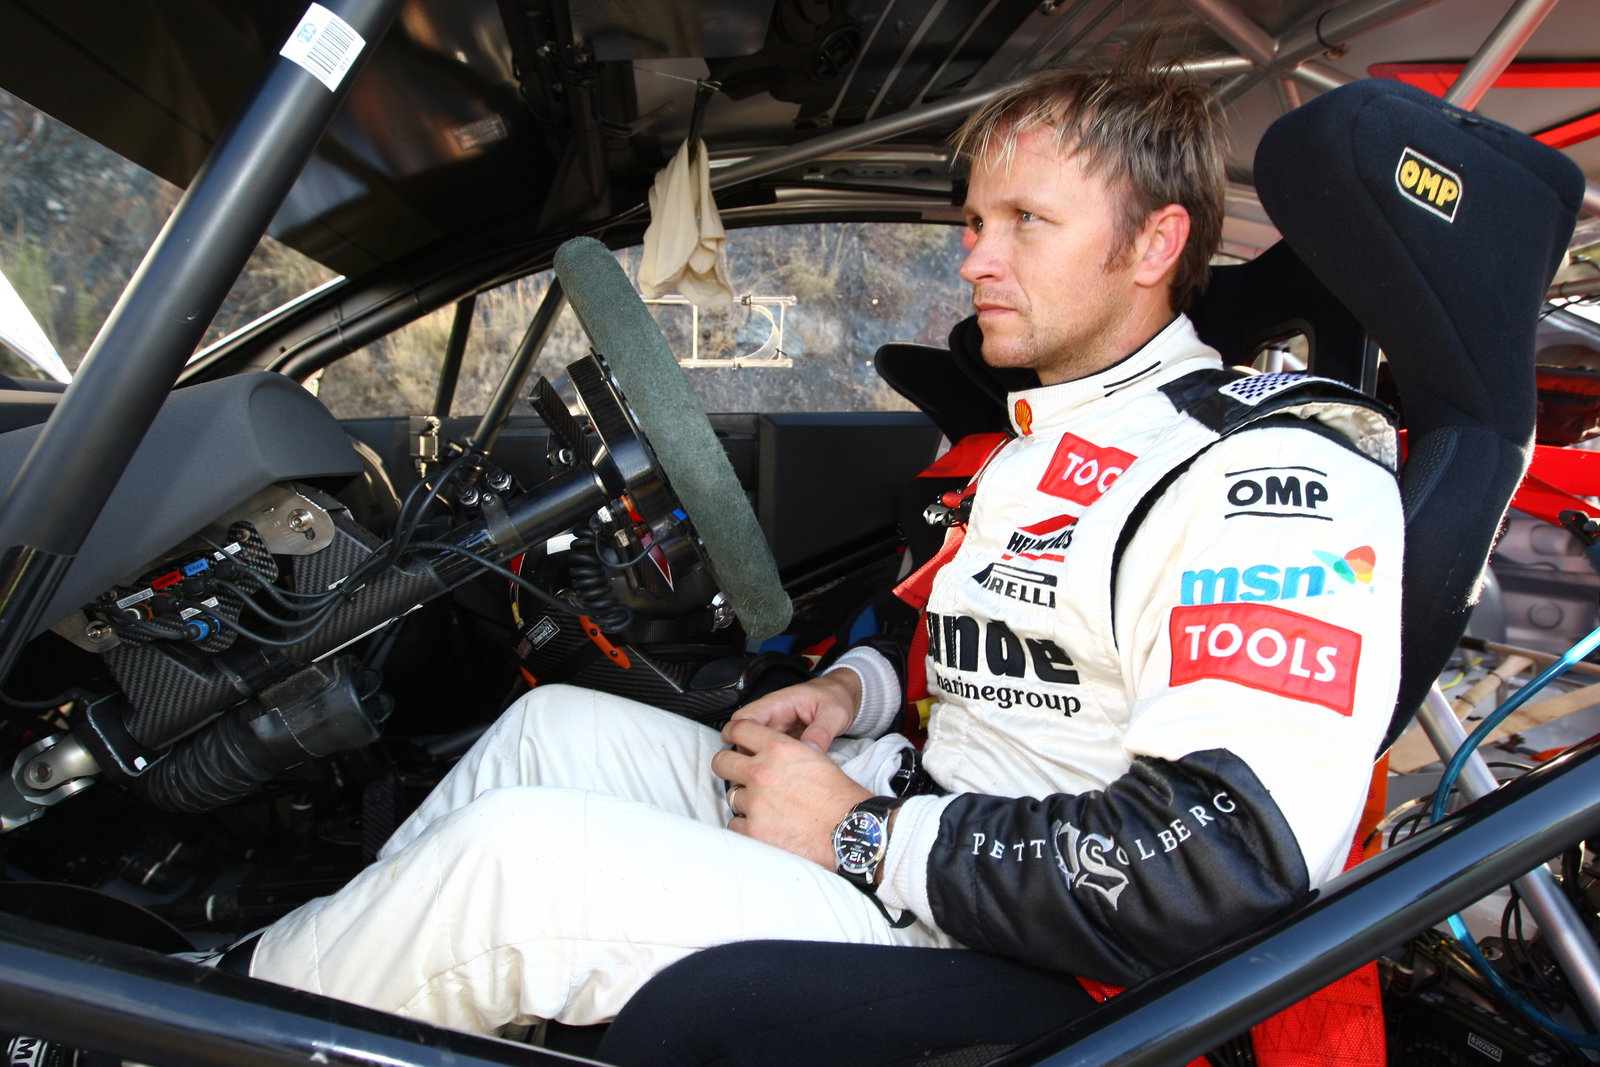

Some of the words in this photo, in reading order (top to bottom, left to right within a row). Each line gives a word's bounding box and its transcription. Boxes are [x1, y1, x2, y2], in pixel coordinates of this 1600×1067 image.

[1399, 159, 1459, 207] OMP
[1226, 475, 1329, 509] OMP
[1180, 564, 1327, 606] msn
[1185, 622, 1338, 682] TOOLS
